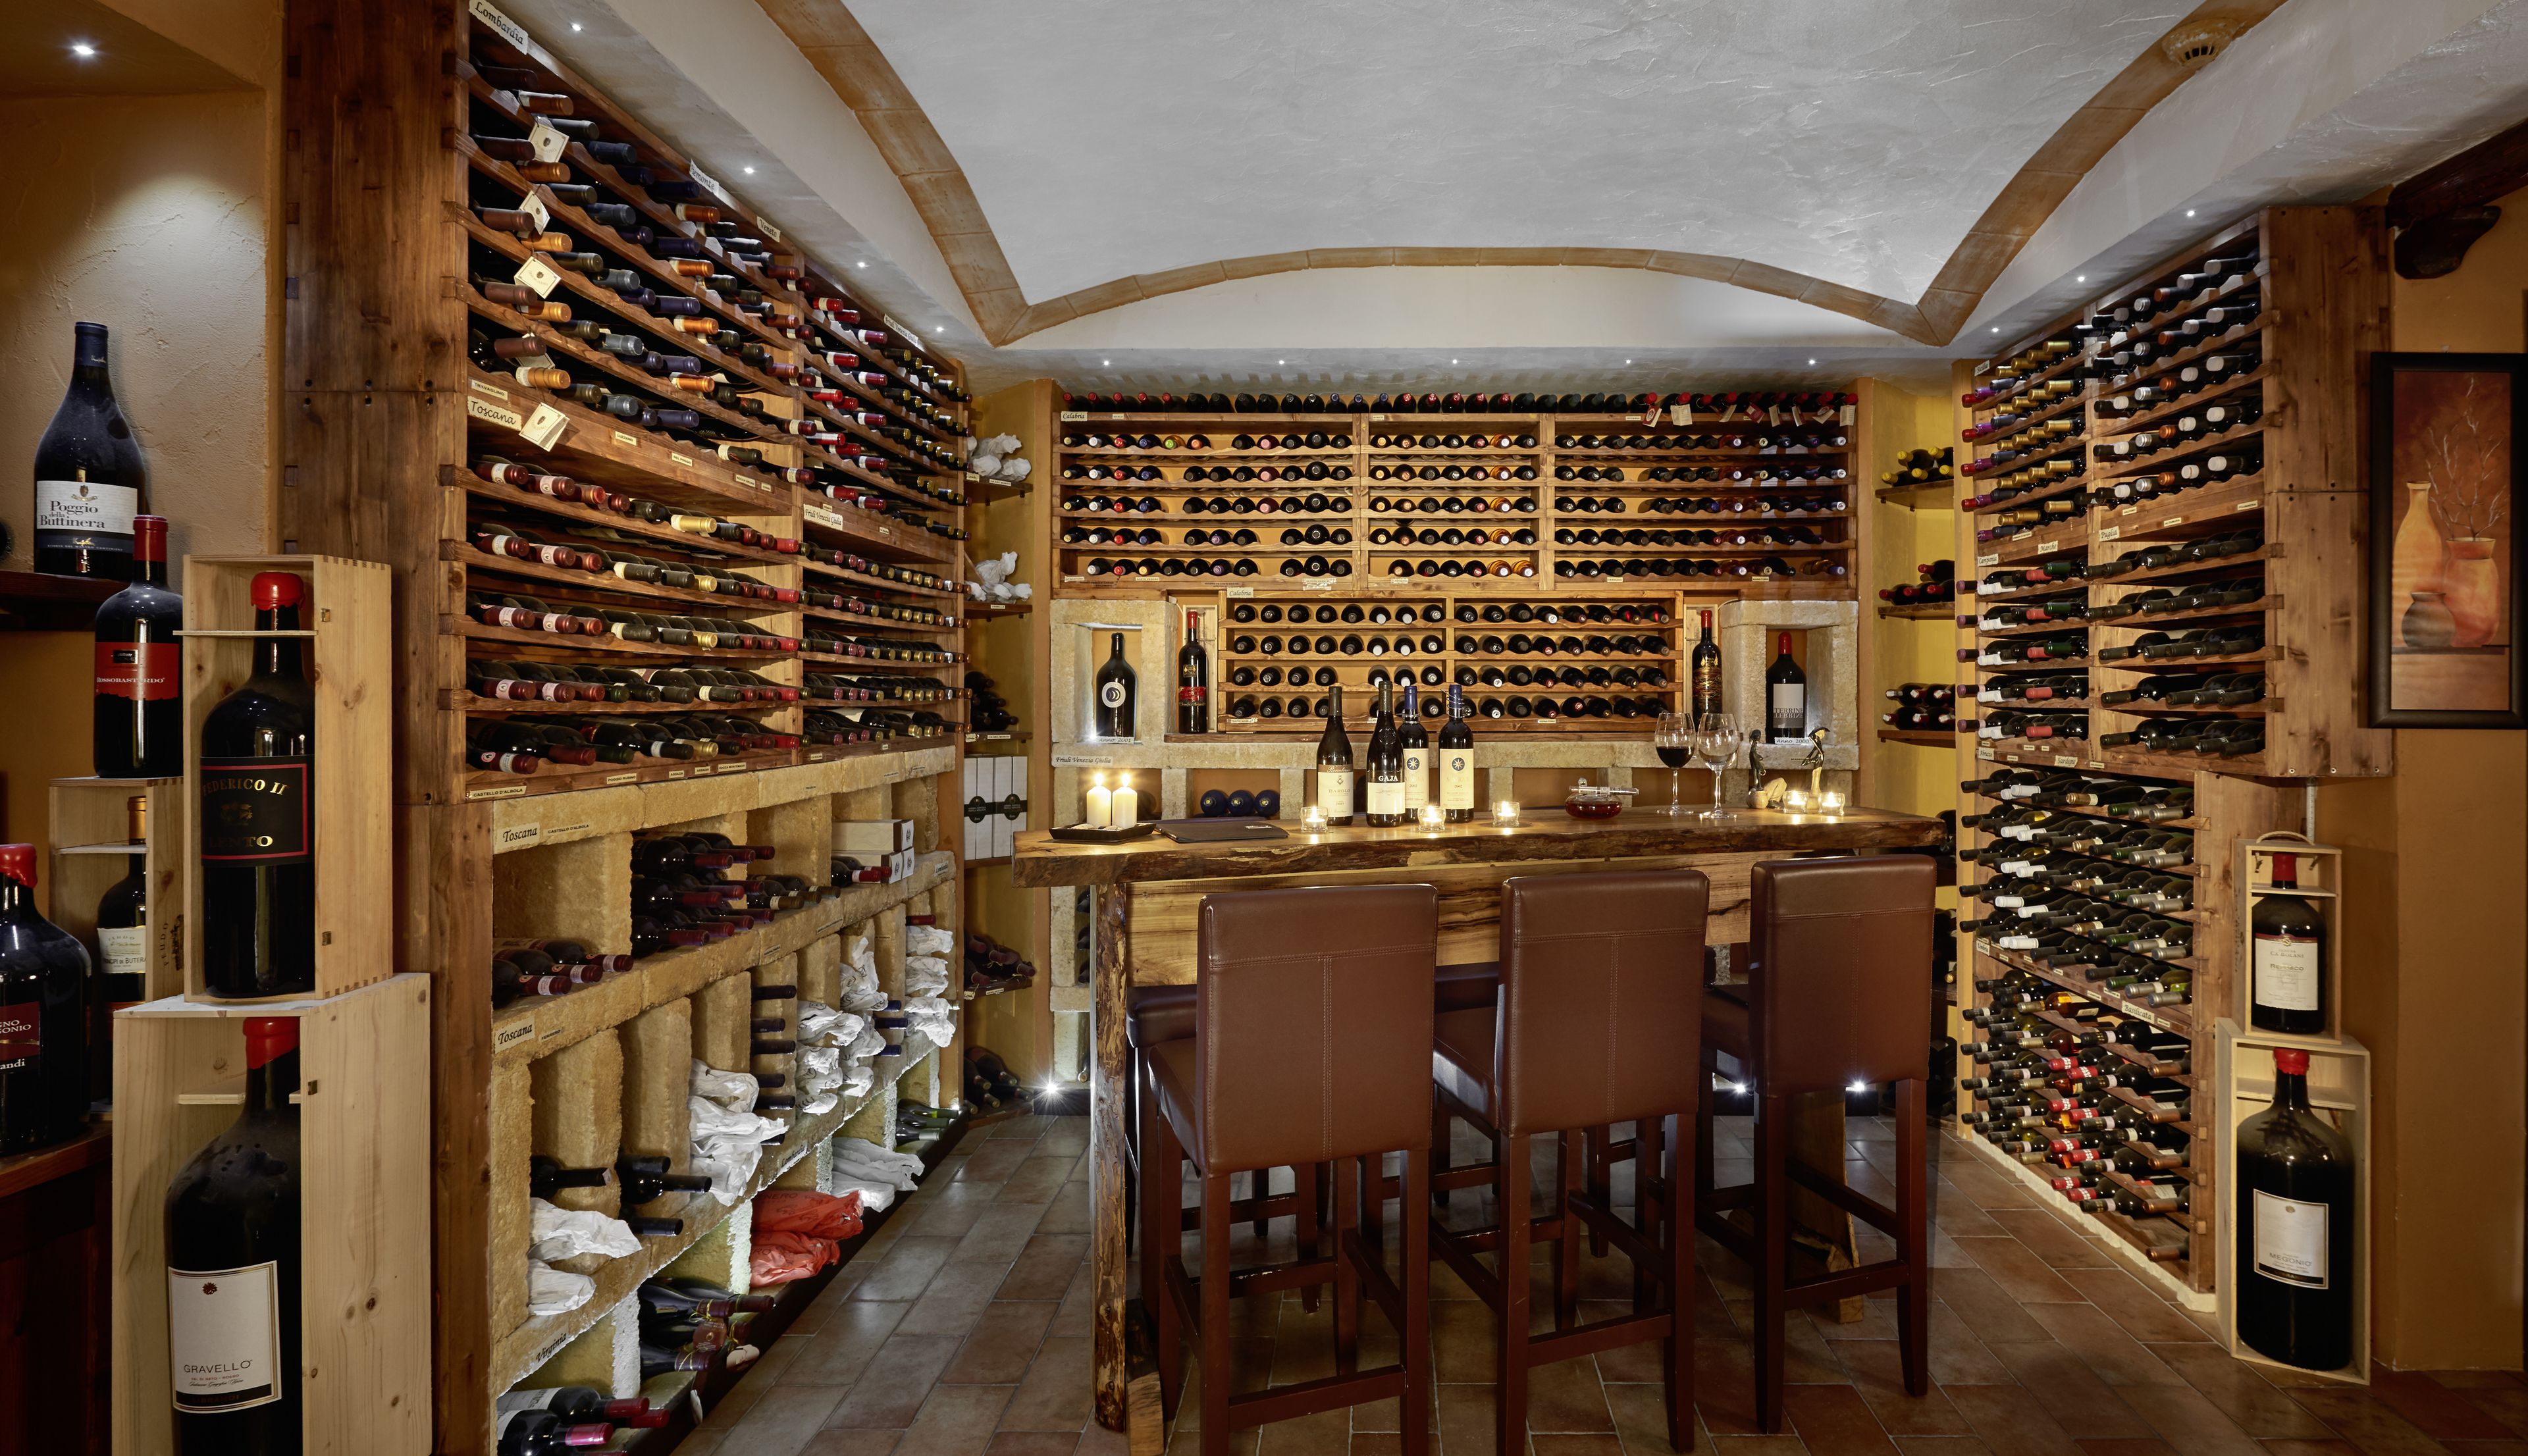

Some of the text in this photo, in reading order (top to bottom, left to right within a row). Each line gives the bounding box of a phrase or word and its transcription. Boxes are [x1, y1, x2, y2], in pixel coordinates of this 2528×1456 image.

[475, 2, 523, 45] Lombardia
[760, 219, 777, 238] Veneto
[474, 382, 505, 396] TRAVAGLINO
[471, 400, 516, 425] Toscana
[50, 500, 98, 515] Poggio
[40, 515, 105, 529] Buttinera
[805, 509, 842, 525] Friuli Venezia Giulia
[2101, 529, 2117, 539] Puglia
[2040, 542, 2057, 553] Marche
[201, 778, 288, 796] FEDERICO II
[502, 826, 538, 843] Toscana
[547, 826, 571, 835] CASTELLO
[2124, 1004, 2152, 1020] Basilicata
[498, 1023, 533, 1045] Toscana
[541, 1029, 561, 1041] FERRERO
[2269, 1252, 2312, 1266] MEGONIO
[529, 1332, 566, 1363] Virginia
[184, 1360, 251, 1373] GRAVELLO
